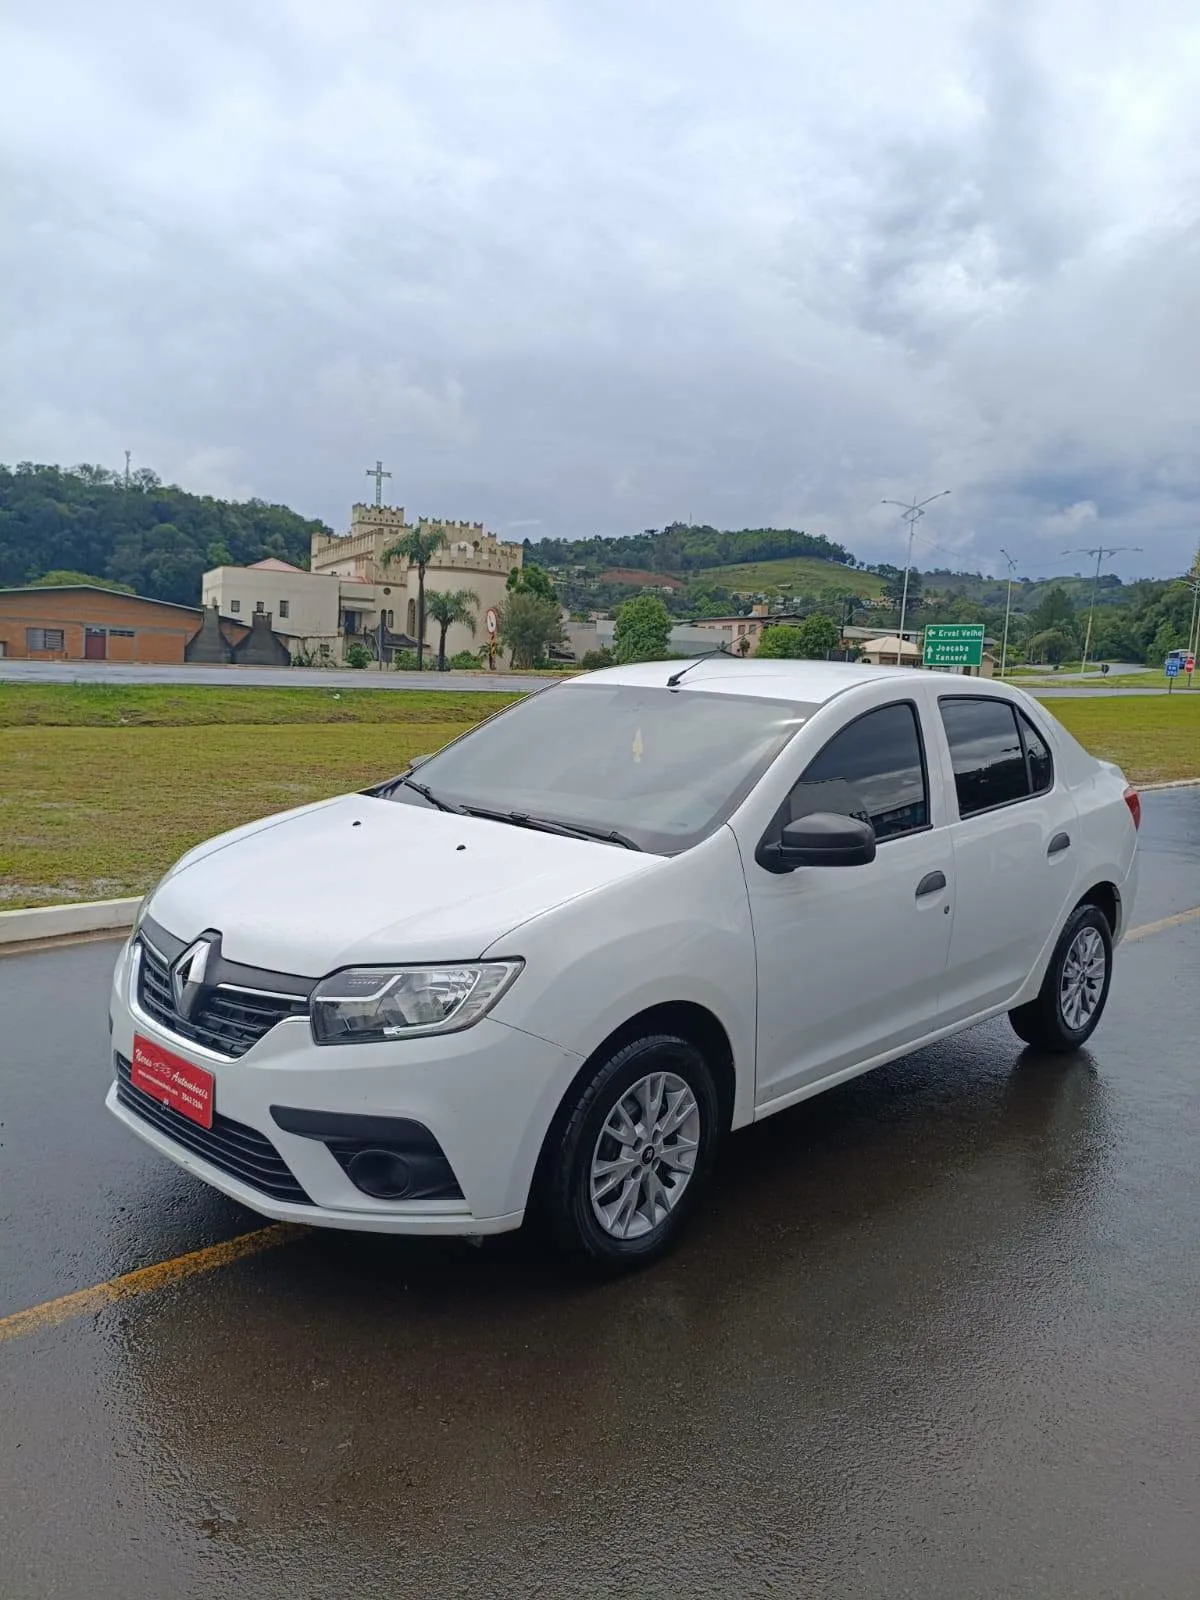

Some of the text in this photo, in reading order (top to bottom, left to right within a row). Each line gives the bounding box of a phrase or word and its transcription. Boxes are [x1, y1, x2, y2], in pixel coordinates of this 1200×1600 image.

[938, 629, 983, 637] Erval Velho
[936, 644, 969, 652] Joaçaba
